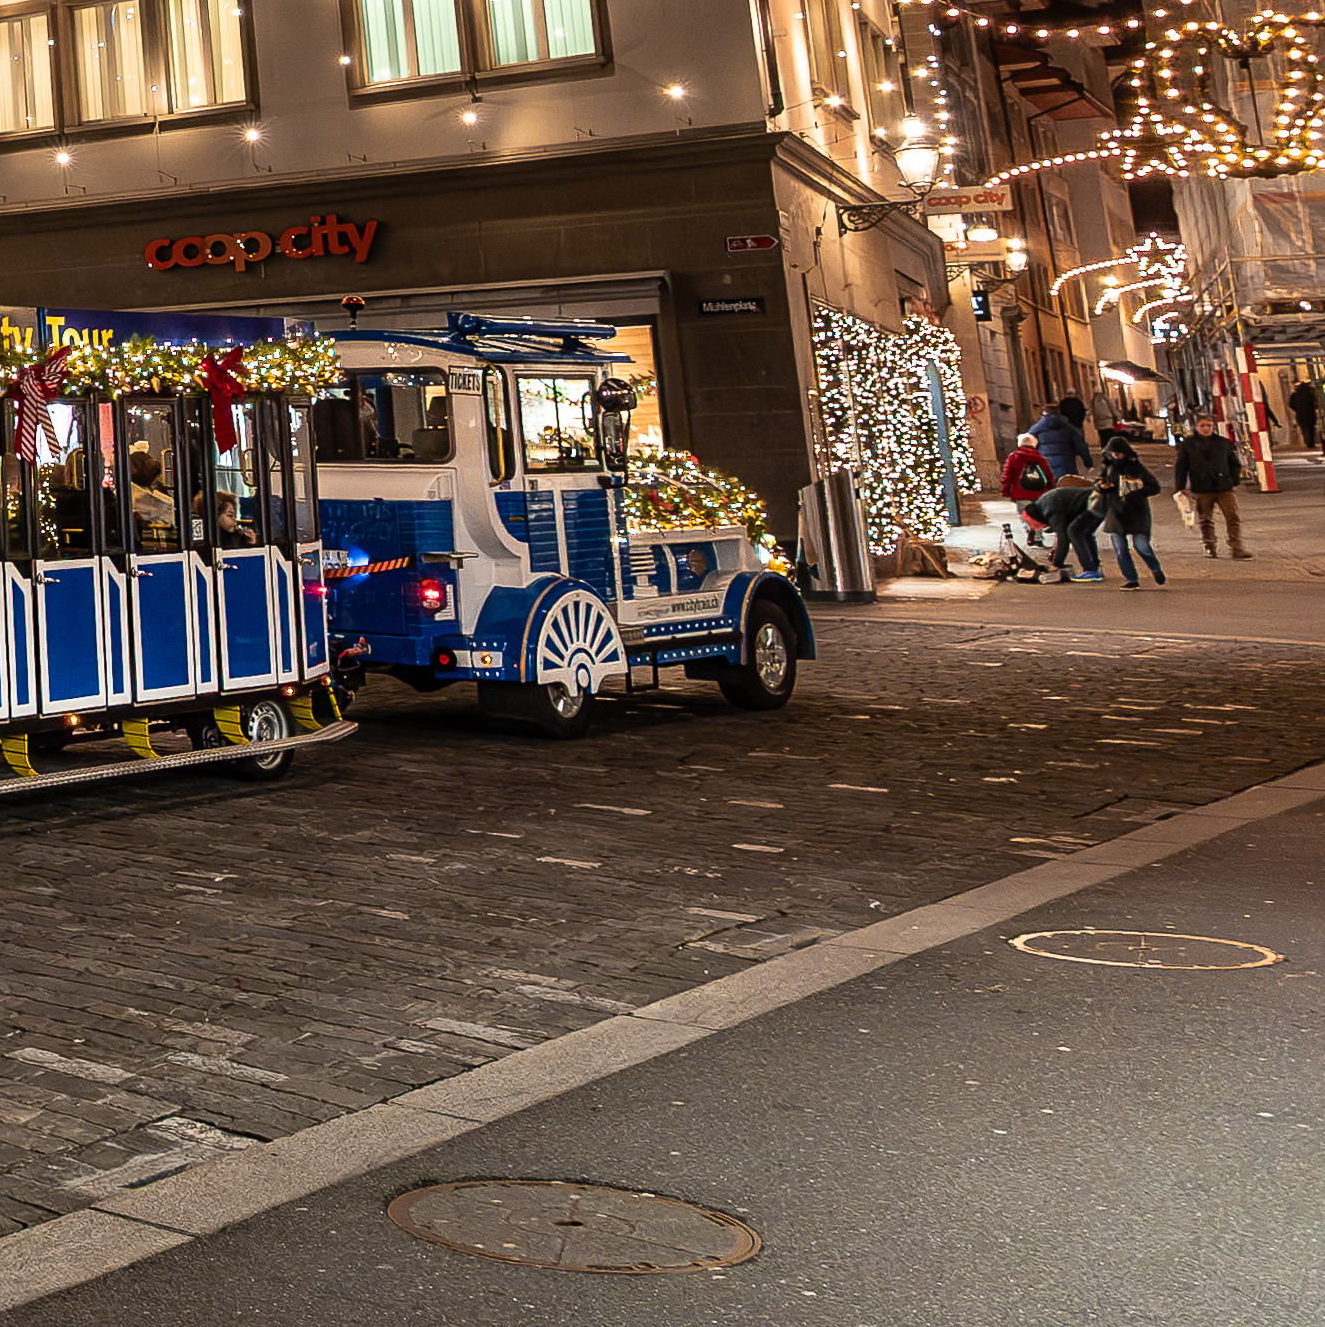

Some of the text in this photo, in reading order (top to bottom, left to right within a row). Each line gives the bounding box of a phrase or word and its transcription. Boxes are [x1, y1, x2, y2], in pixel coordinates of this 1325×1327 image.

[927, 192, 1006, 208] coop city
[144, 213, 378, 273] coop city
